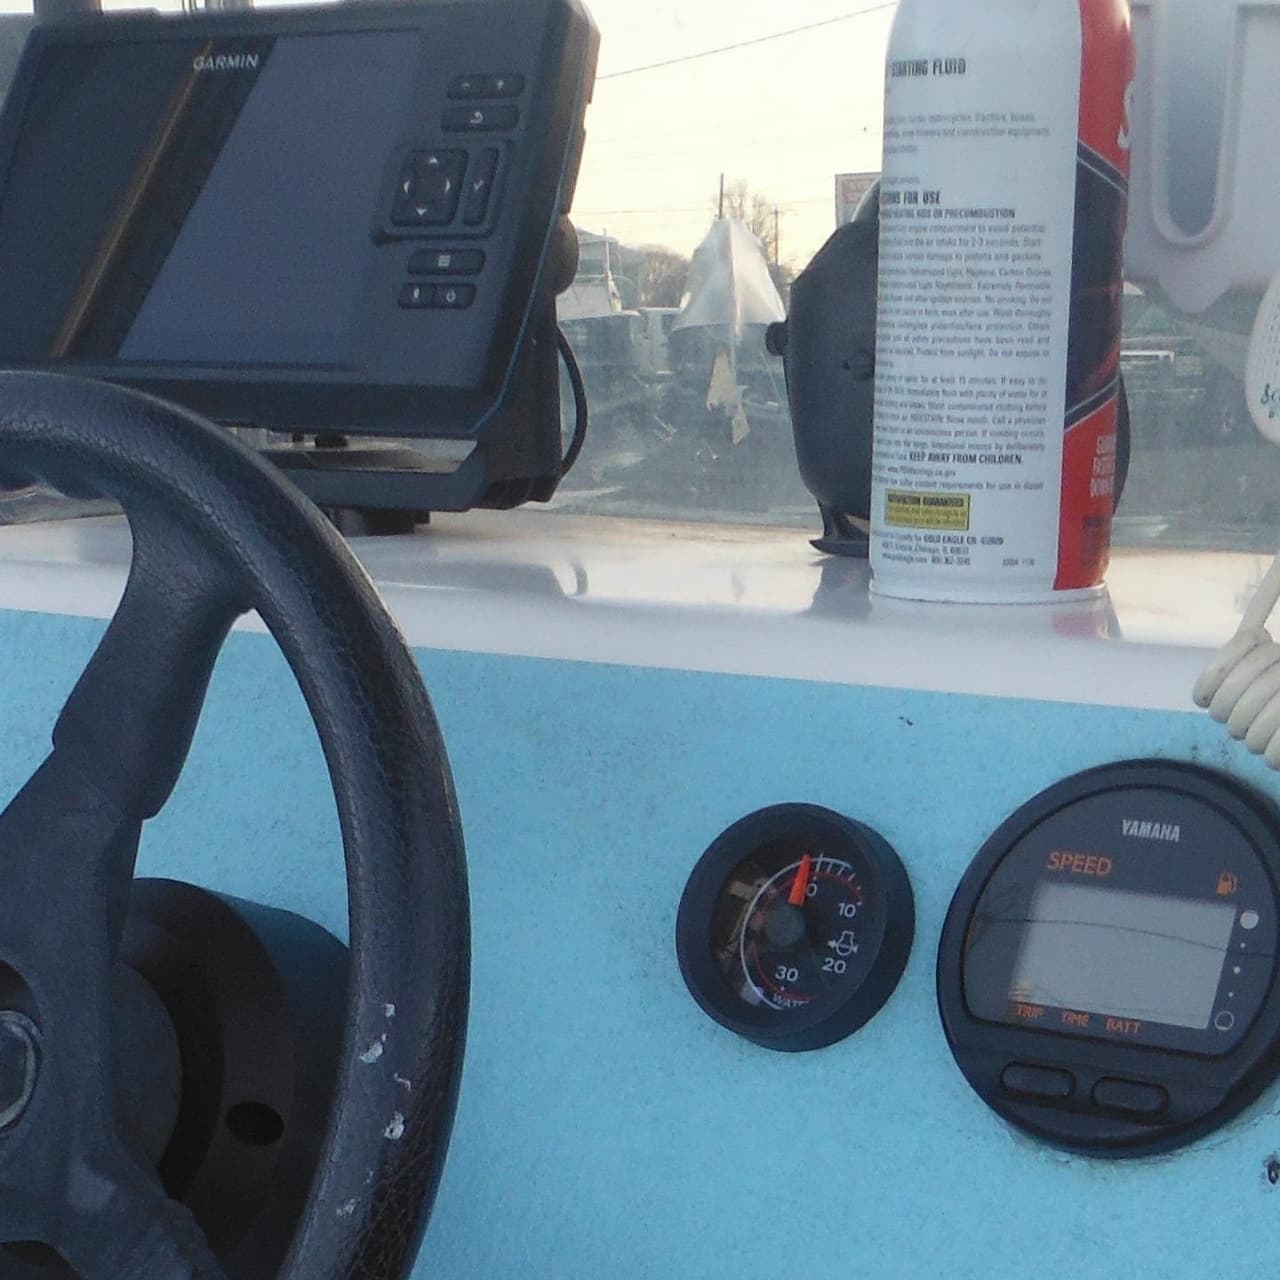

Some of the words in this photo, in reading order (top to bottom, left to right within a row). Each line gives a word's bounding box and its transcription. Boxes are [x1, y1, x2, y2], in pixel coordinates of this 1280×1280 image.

[193, 54, 259, 71] GARMIN
[933, 58, 966, 75] FLUID
[904, 191, 918, 205] FOR
[922, 191, 941, 205] USE
[909, 451, 926, 461] KEEP
[927, 452, 950, 462] AWAY
[952, 453, 977, 463] FROM
[1122, 819, 1180, 842] YAMAHA
[1047, 852, 1112, 877] SPEED
[838, 903, 857, 918] 10
[775, 965, 799, 981] 30
[822, 958, 847, 973] 20
[1016, 1002, 1045, 1018] TRIP
[1062, 1010, 1089, 1027] TIME
[1105, 1018, 1141, 1034] BATT
